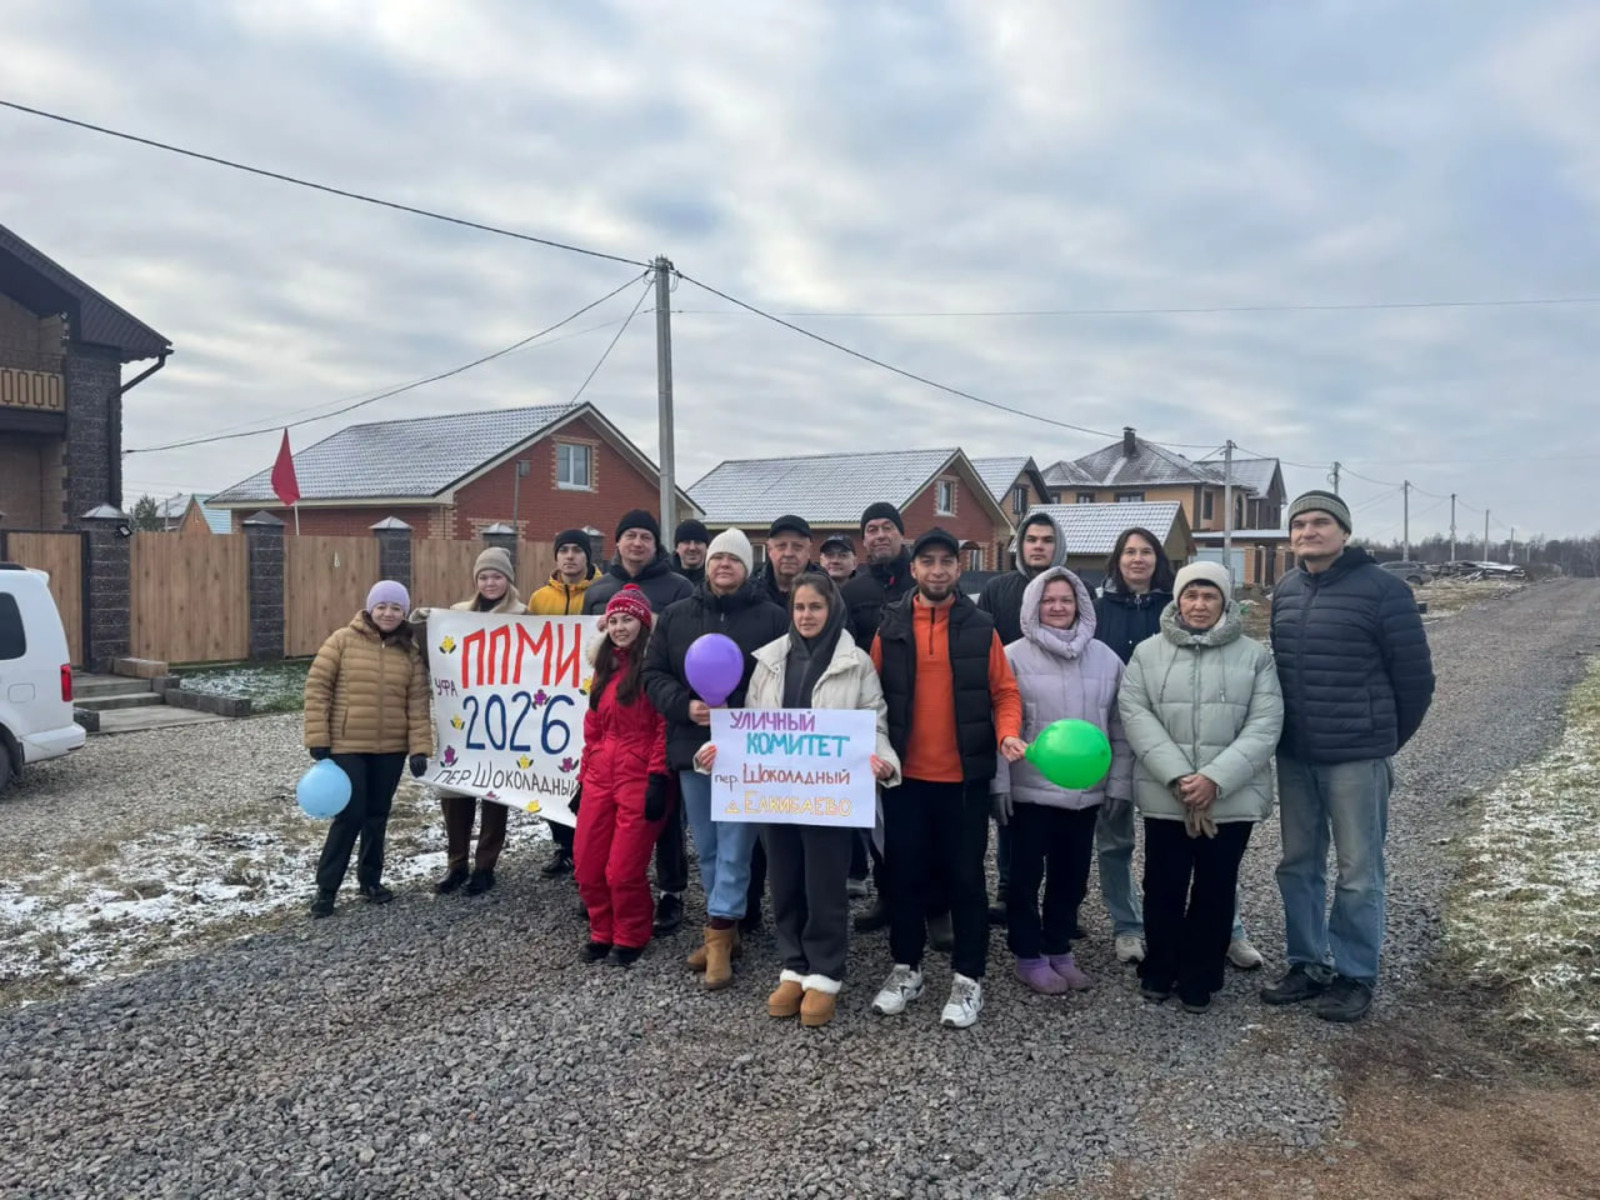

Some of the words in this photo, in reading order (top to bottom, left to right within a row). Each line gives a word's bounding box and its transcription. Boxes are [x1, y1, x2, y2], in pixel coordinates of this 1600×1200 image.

[461, 621, 582, 689] ППМИ
[434, 677, 459, 697] УФА
[462, 691, 575, 755] 2026
[729, 710, 816, 732] УЛИЧНЫЙ
[746, 732, 851, 758] КОМИТЕТ
